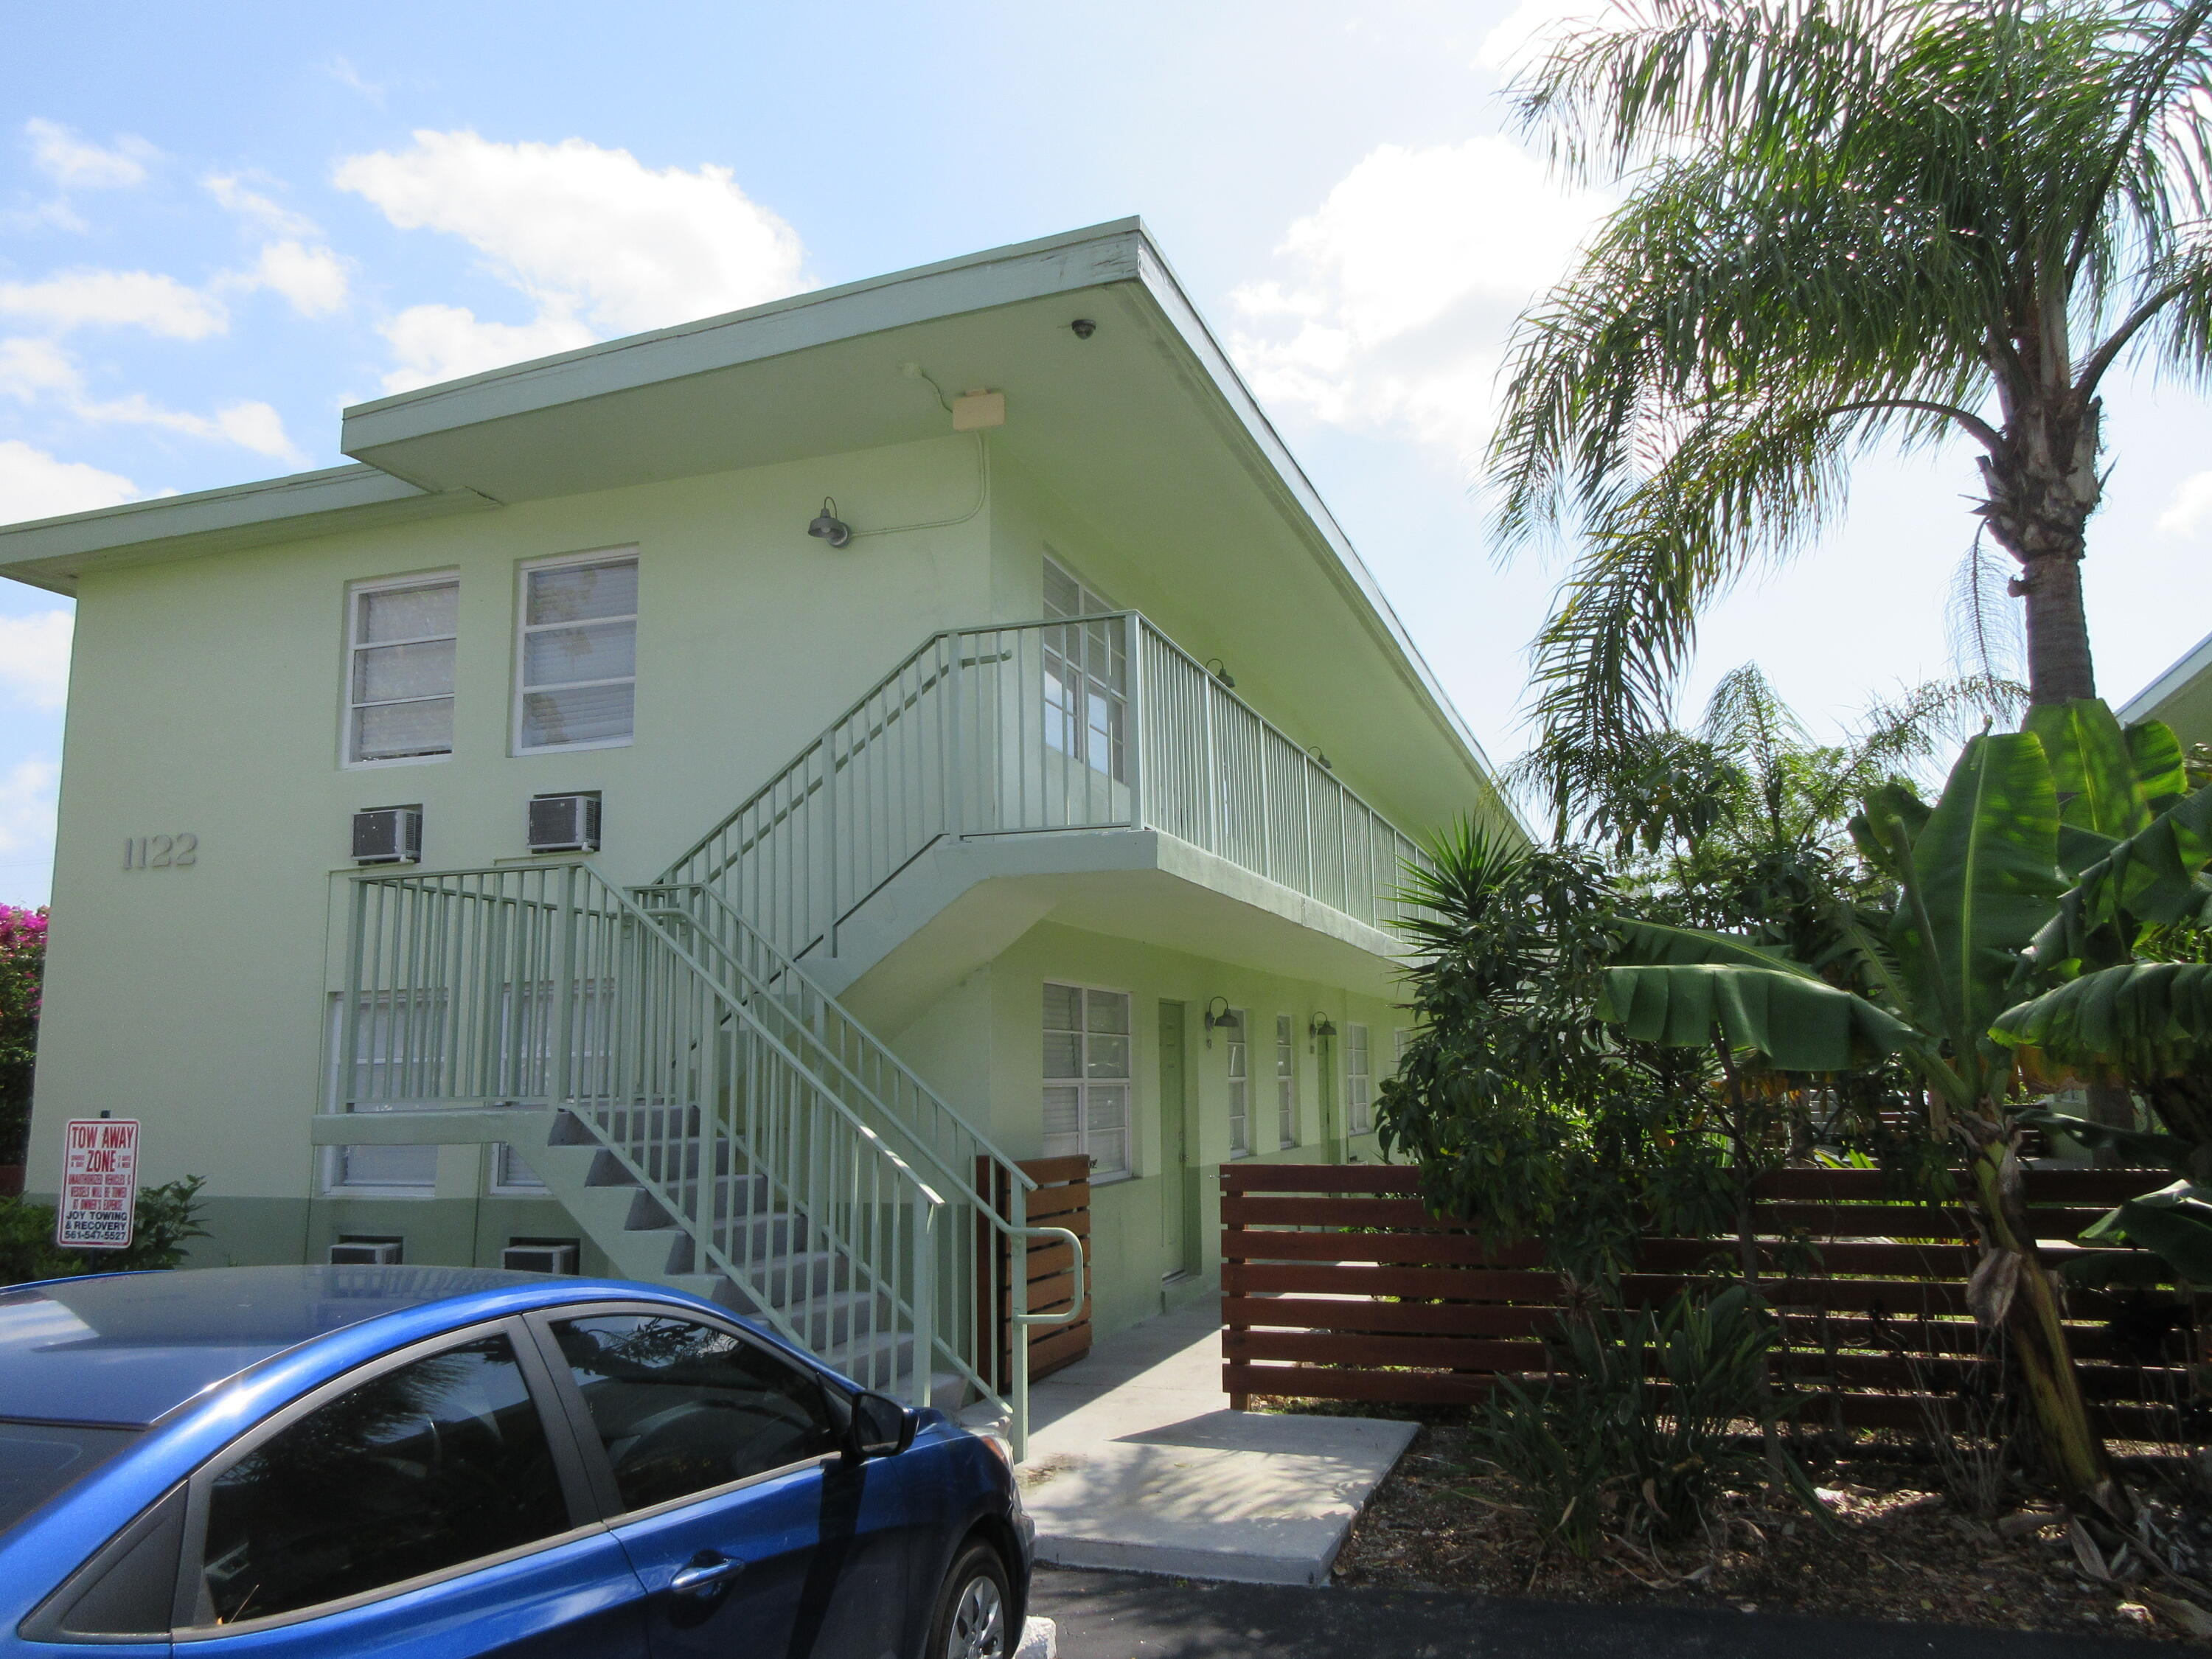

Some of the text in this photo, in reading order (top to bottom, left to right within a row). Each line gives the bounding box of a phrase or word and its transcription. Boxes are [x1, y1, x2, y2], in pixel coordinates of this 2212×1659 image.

[124, 832, 198, 869] 1122
[72, 1126, 134, 1149] TOW AWAY
[86, 1150, 116, 1172] ZONE
[66, 1211, 128, 1221] JOY TOWING
[65, 1221, 127, 1231] & RECOVERY
[64, 1231, 126, 1240] 561-547-5527
